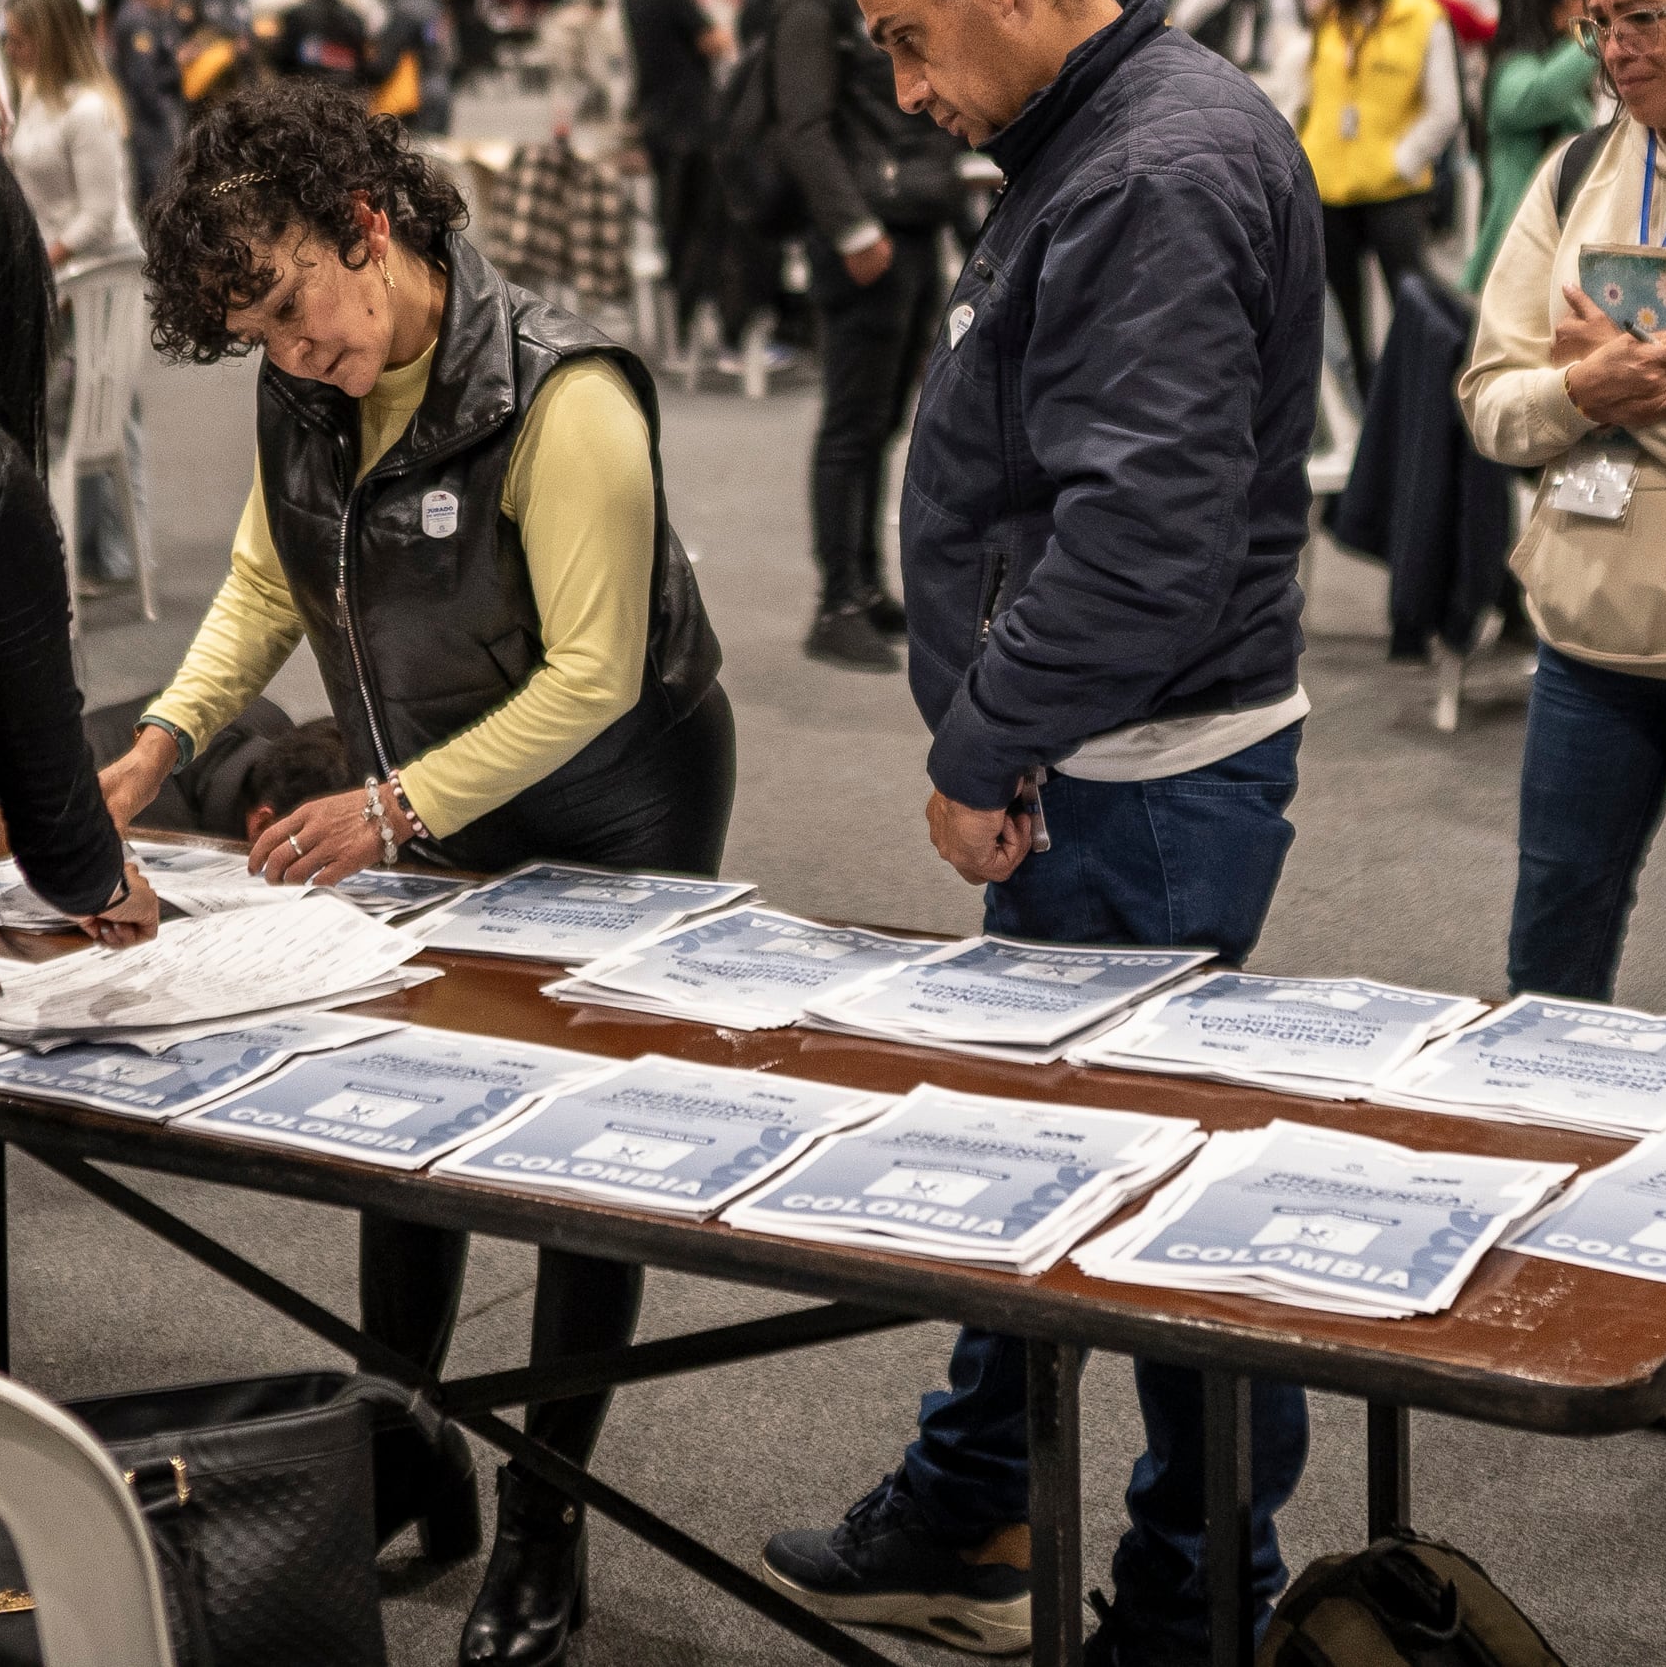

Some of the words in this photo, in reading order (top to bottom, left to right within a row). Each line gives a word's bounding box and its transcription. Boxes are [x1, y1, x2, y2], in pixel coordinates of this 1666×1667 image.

[427, 506, 453, 514] JURADO
[994, 948, 1173, 967] COLOMBIA
[1199, 1023, 1372, 1047] PRESIDENCIA
[1488, 1062, 1664, 1093] PRESIDENCIA
[228, 1106, 419, 1151] COLOMBIA
[492, 1152, 703, 1195] COLOMBIA
[781, 1193, 1005, 1236] COLOMBIA
[1165, 1243, 1410, 1289] COLOMBIA
